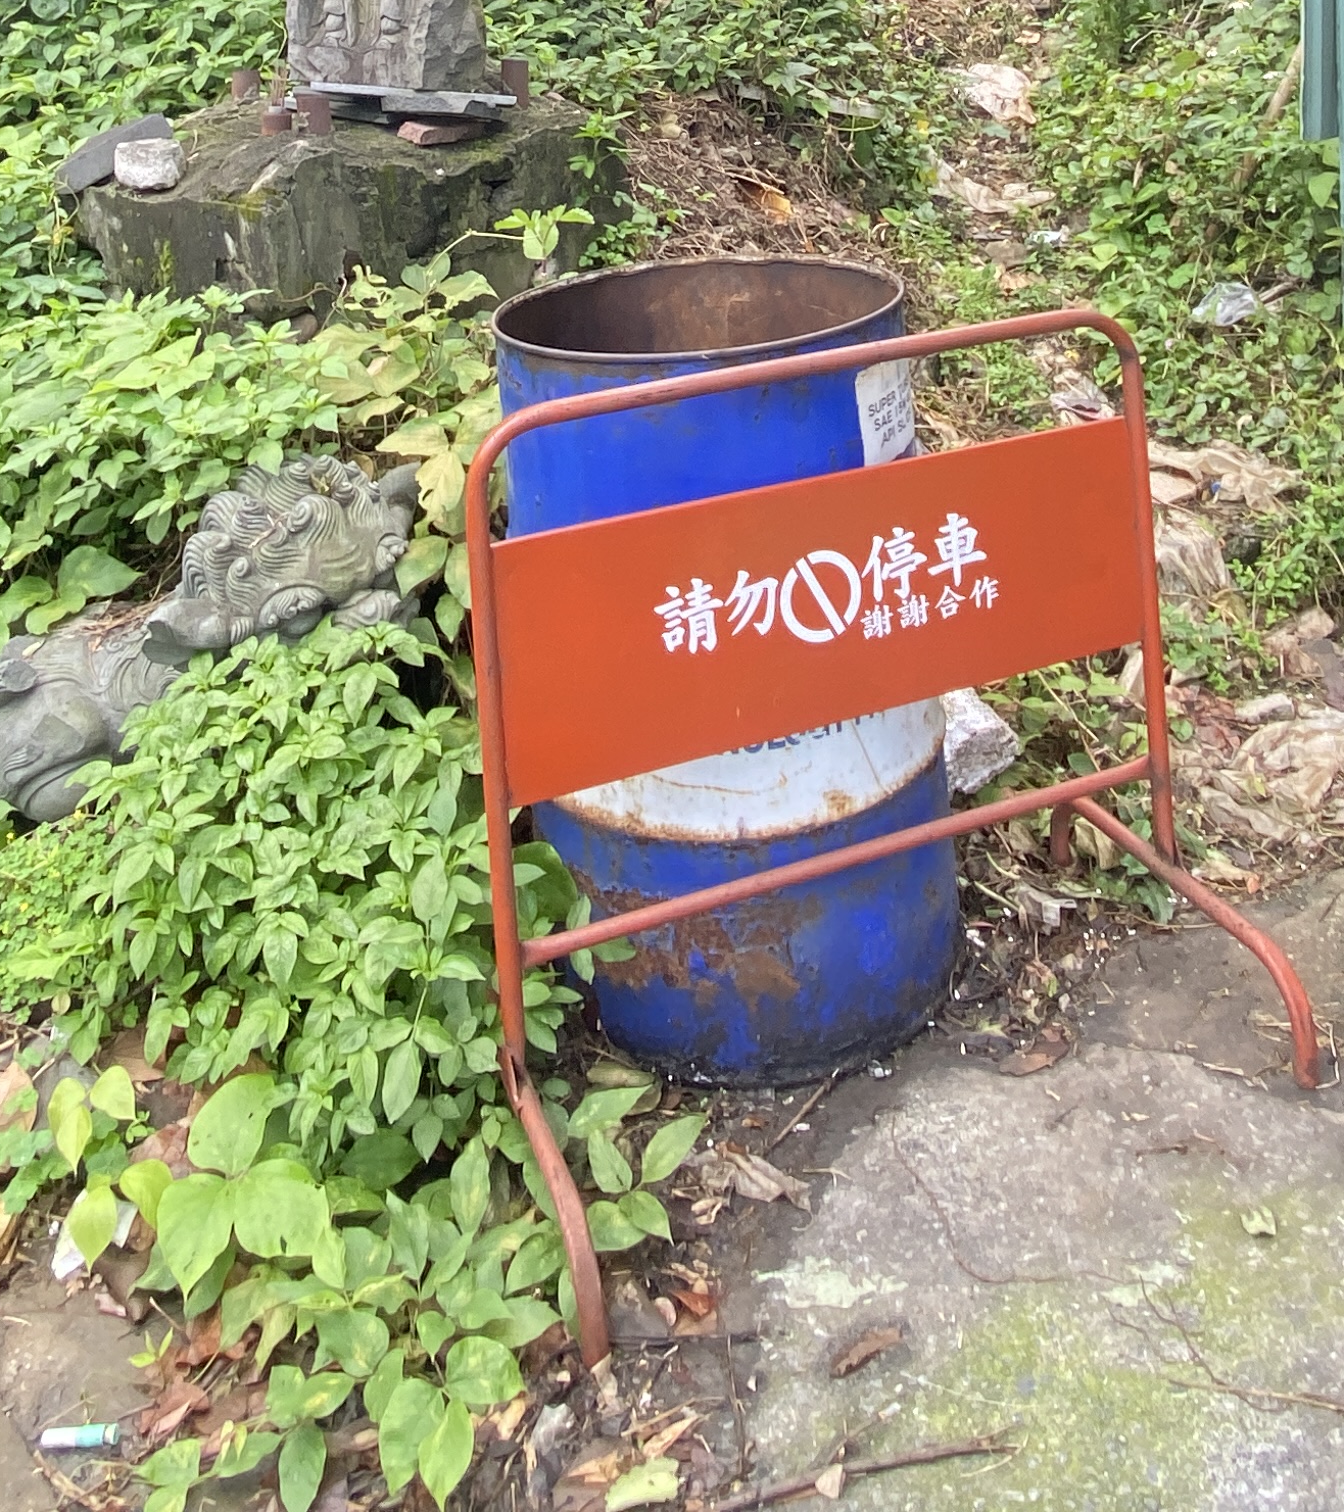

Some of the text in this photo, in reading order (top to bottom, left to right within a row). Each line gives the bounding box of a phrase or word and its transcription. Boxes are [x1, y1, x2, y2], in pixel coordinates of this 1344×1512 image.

[868, 390, 896, 417] SUPER
[874, 409, 893, 432] SAE
[860, 575, 999, 640] 謝謝合作
